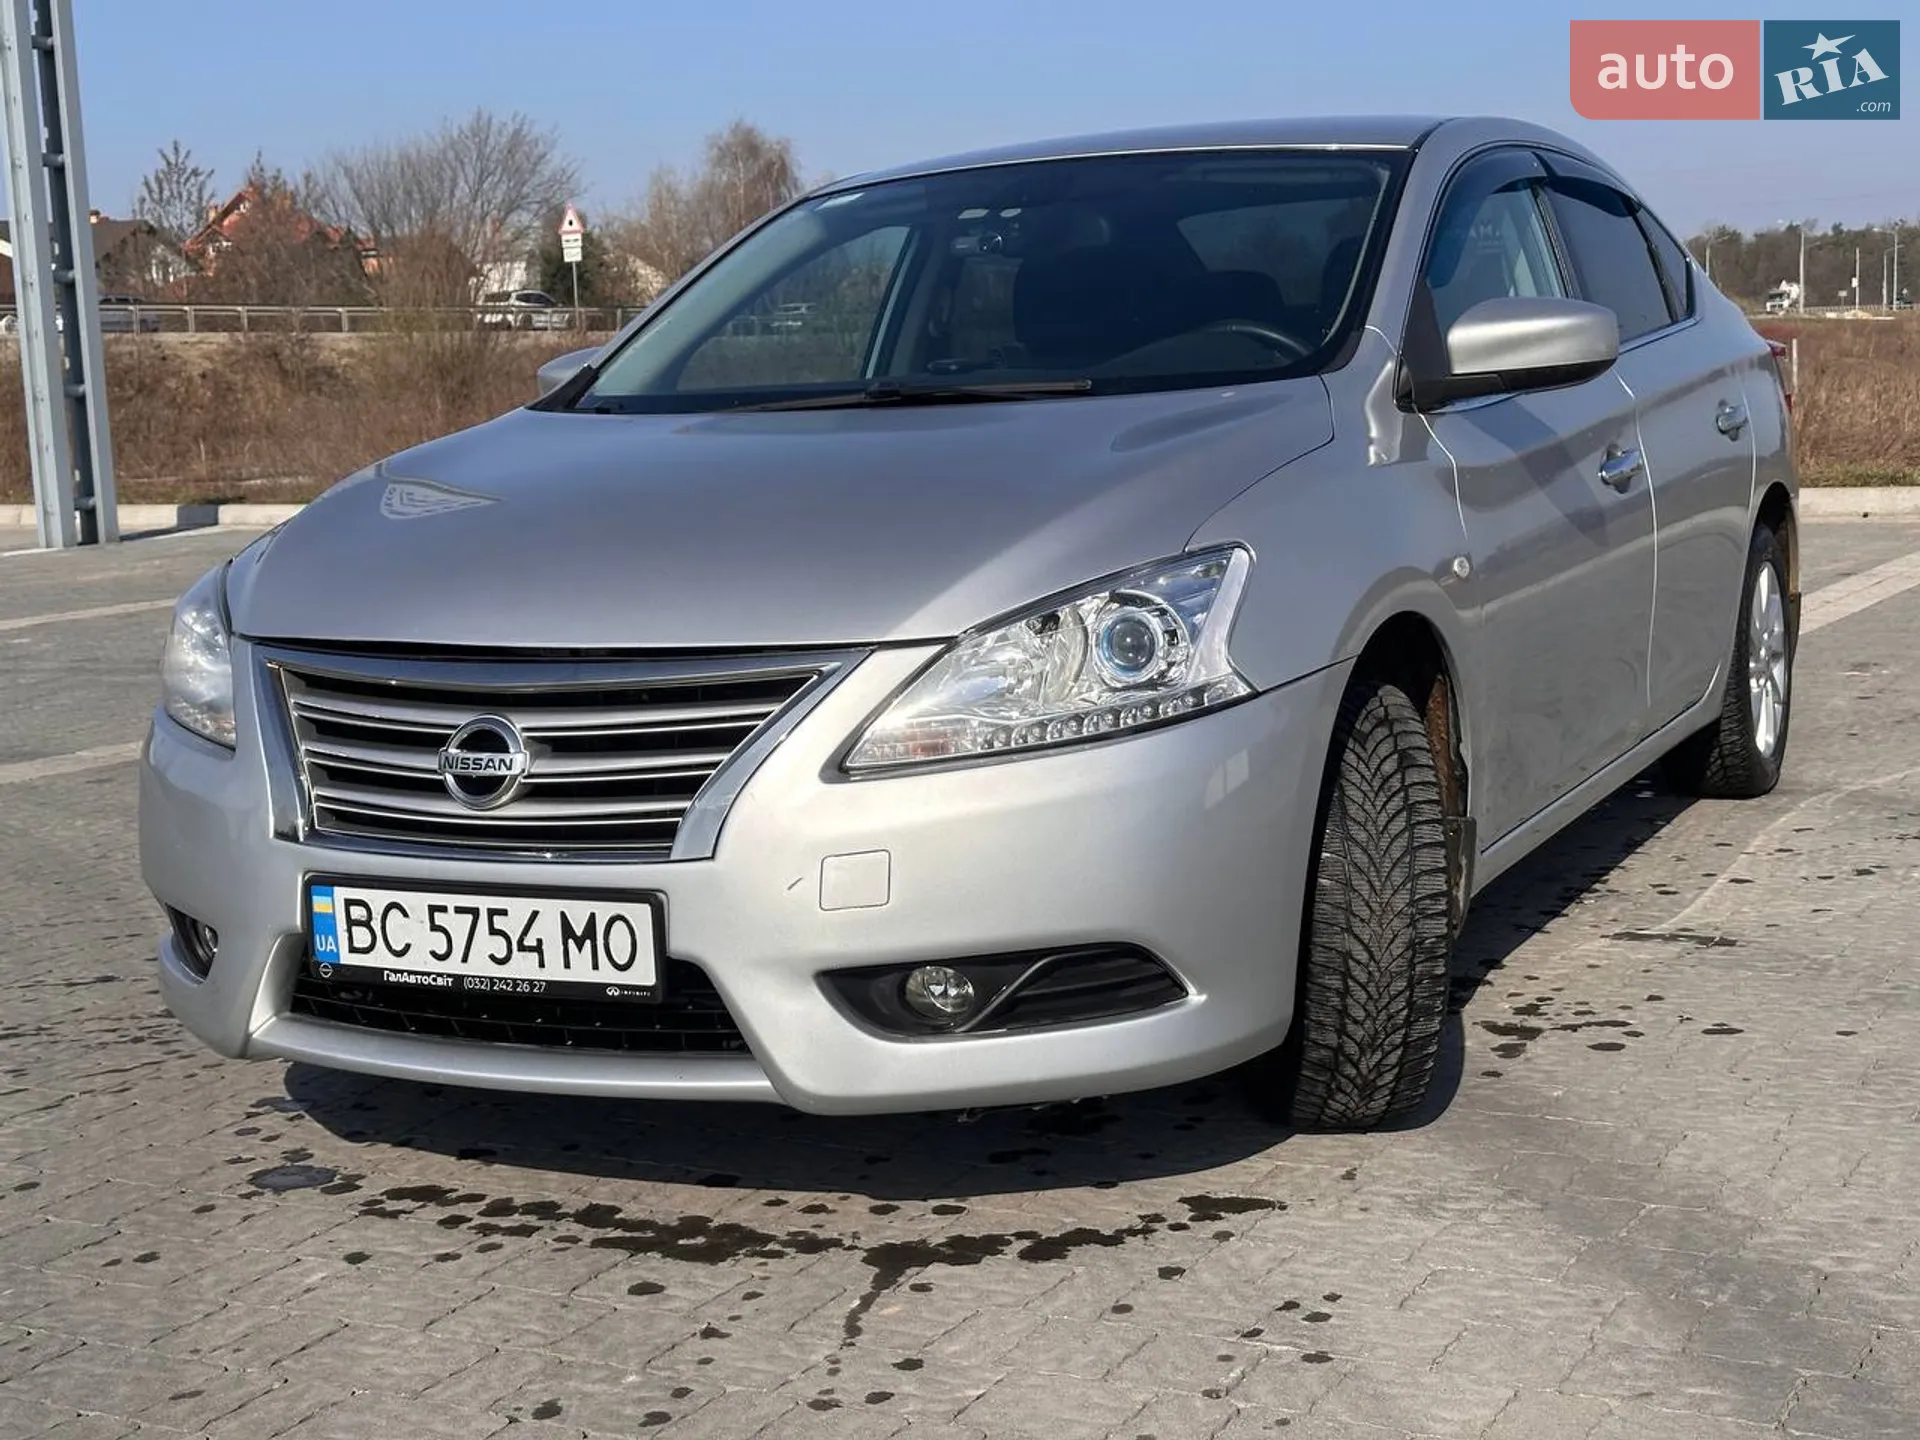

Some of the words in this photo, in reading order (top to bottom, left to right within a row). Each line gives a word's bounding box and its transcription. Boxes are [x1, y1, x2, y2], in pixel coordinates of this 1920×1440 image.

[442, 756, 513, 771] NISSAN
[316, 934, 337, 952] UA
[343, 897, 412, 958] BC
[426, 904, 546, 969] 5754
[559, 910, 638, 972] MO
[383, 970, 455, 987] ГалАвтоСвіт
[463, 976, 491, 991] (032)
[493, 978, 513, 991] 242
[515, 979, 531, 993] 26
[532, 981, 546, 993] 27
